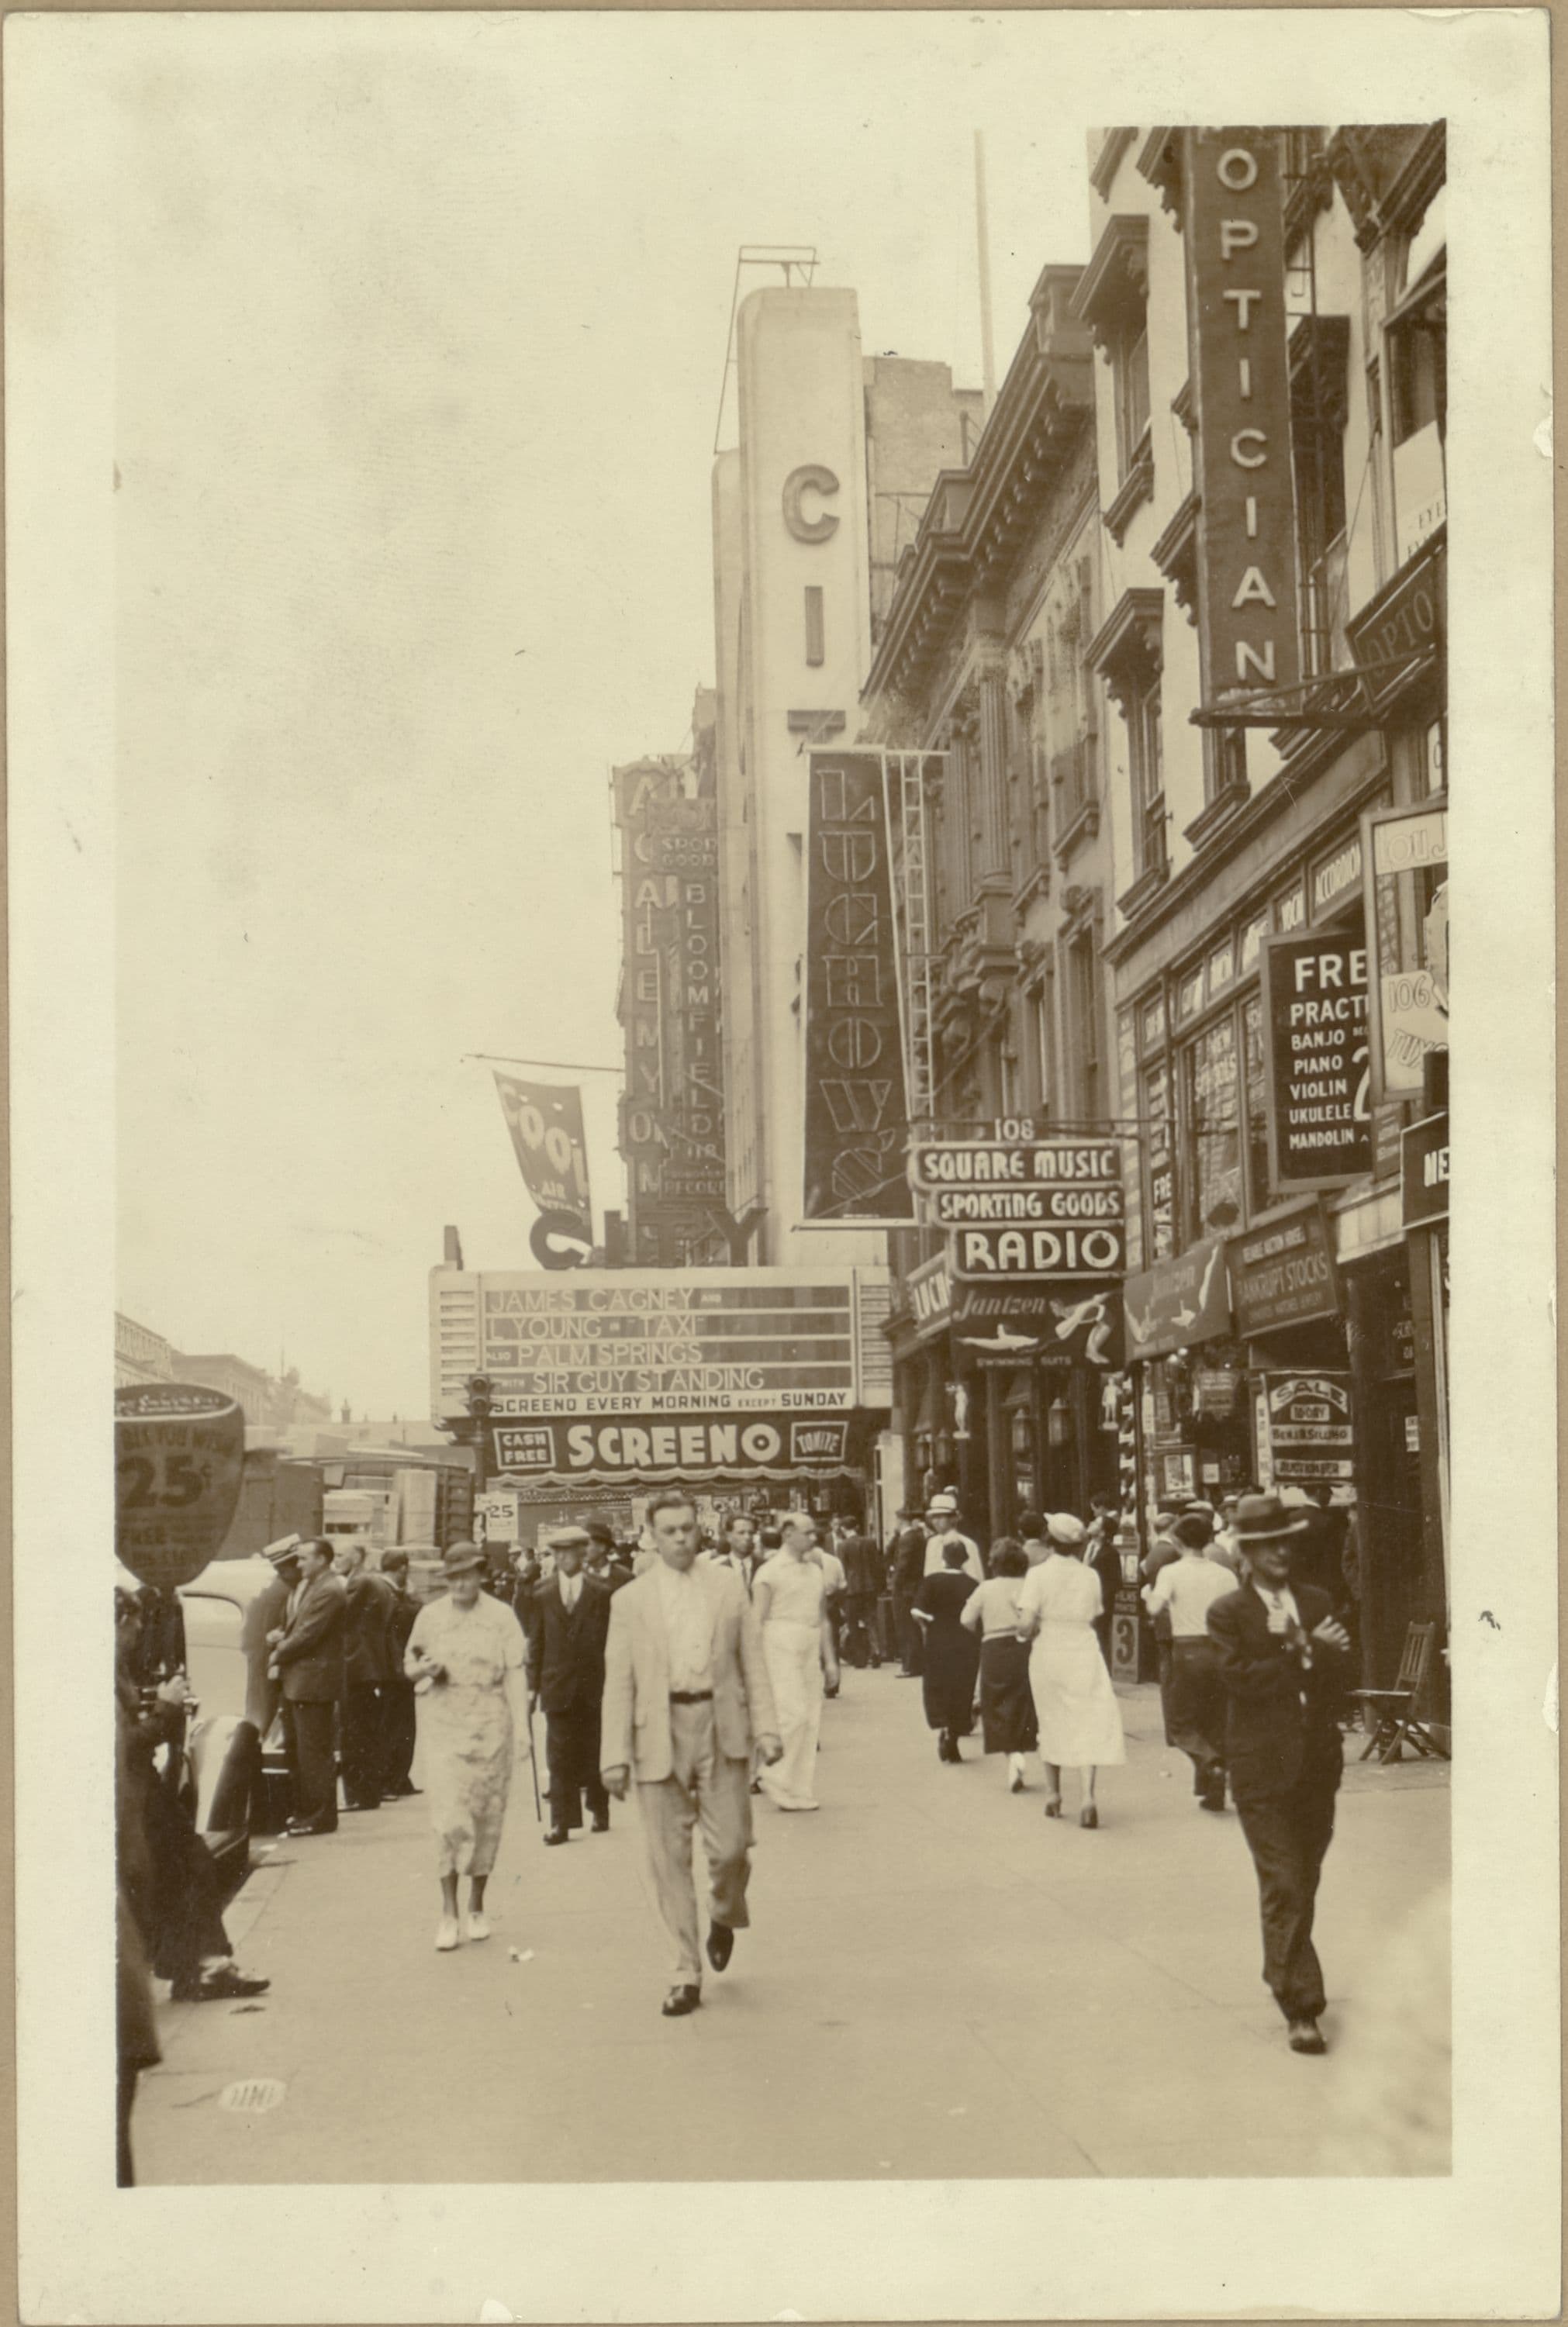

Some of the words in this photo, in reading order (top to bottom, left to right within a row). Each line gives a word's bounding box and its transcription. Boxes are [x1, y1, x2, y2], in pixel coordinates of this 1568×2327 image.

[1215, 147, 1278, 682] OPTICIAN
[1389, 974, 1432, 1014] 106
[1290, 1028, 1346, 1051] BANJO
[1293, 1055, 1343, 1075] PIANO
[1290, 1078, 1348, 1101] VIOLIN
[1289, 1103, 1352, 1125] UKULELE
[994, 1118, 1034, 1142] 108
[1289, 1127, 1356, 1151] MANDOLIN
[924, 1150, 1025, 1181] SQUARE
[1034, 1148, 1114, 1179] MUSIC
[940, 1191, 1043, 1220] SPORTING
[1051, 1190, 1120, 1217] GOODS
[964, 1230, 1120, 1271] RADIO
[489, 1290, 576, 1312] JAMES
[588, 1288, 695, 1311] CAGNEY
[952, 1290, 1046, 1322] Jantzen
[490, 1318, 503, 1340] L
[512, 1317, 603, 1339] YOUNG
[518, 1345, 592, 1365] PALM
[598, 1341, 703, 1365] SPRINGS
[533, 1372, 570, 1393] SIR
[576, 1370, 628, 1393] GUY
[636, 1368, 765, 1392] STANDING
[1276, 1381, 1344, 1404] SALE
[492, 1398, 578, 1414] SCREENO
[585, 1397, 642, 1411] EVERY
[651, 1395, 731, 1410] MORNING
[737, 1398, 776, 1408] EXCEPT
[781, 1393, 848, 1407] SUNDAY
[502, 1433, 547, 1448] CASH
[567, 1422, 782, 1468] SCREENO
[795, 1431, 844, 1455] TONITE
[503, 1447, 548, 1463] FREE
